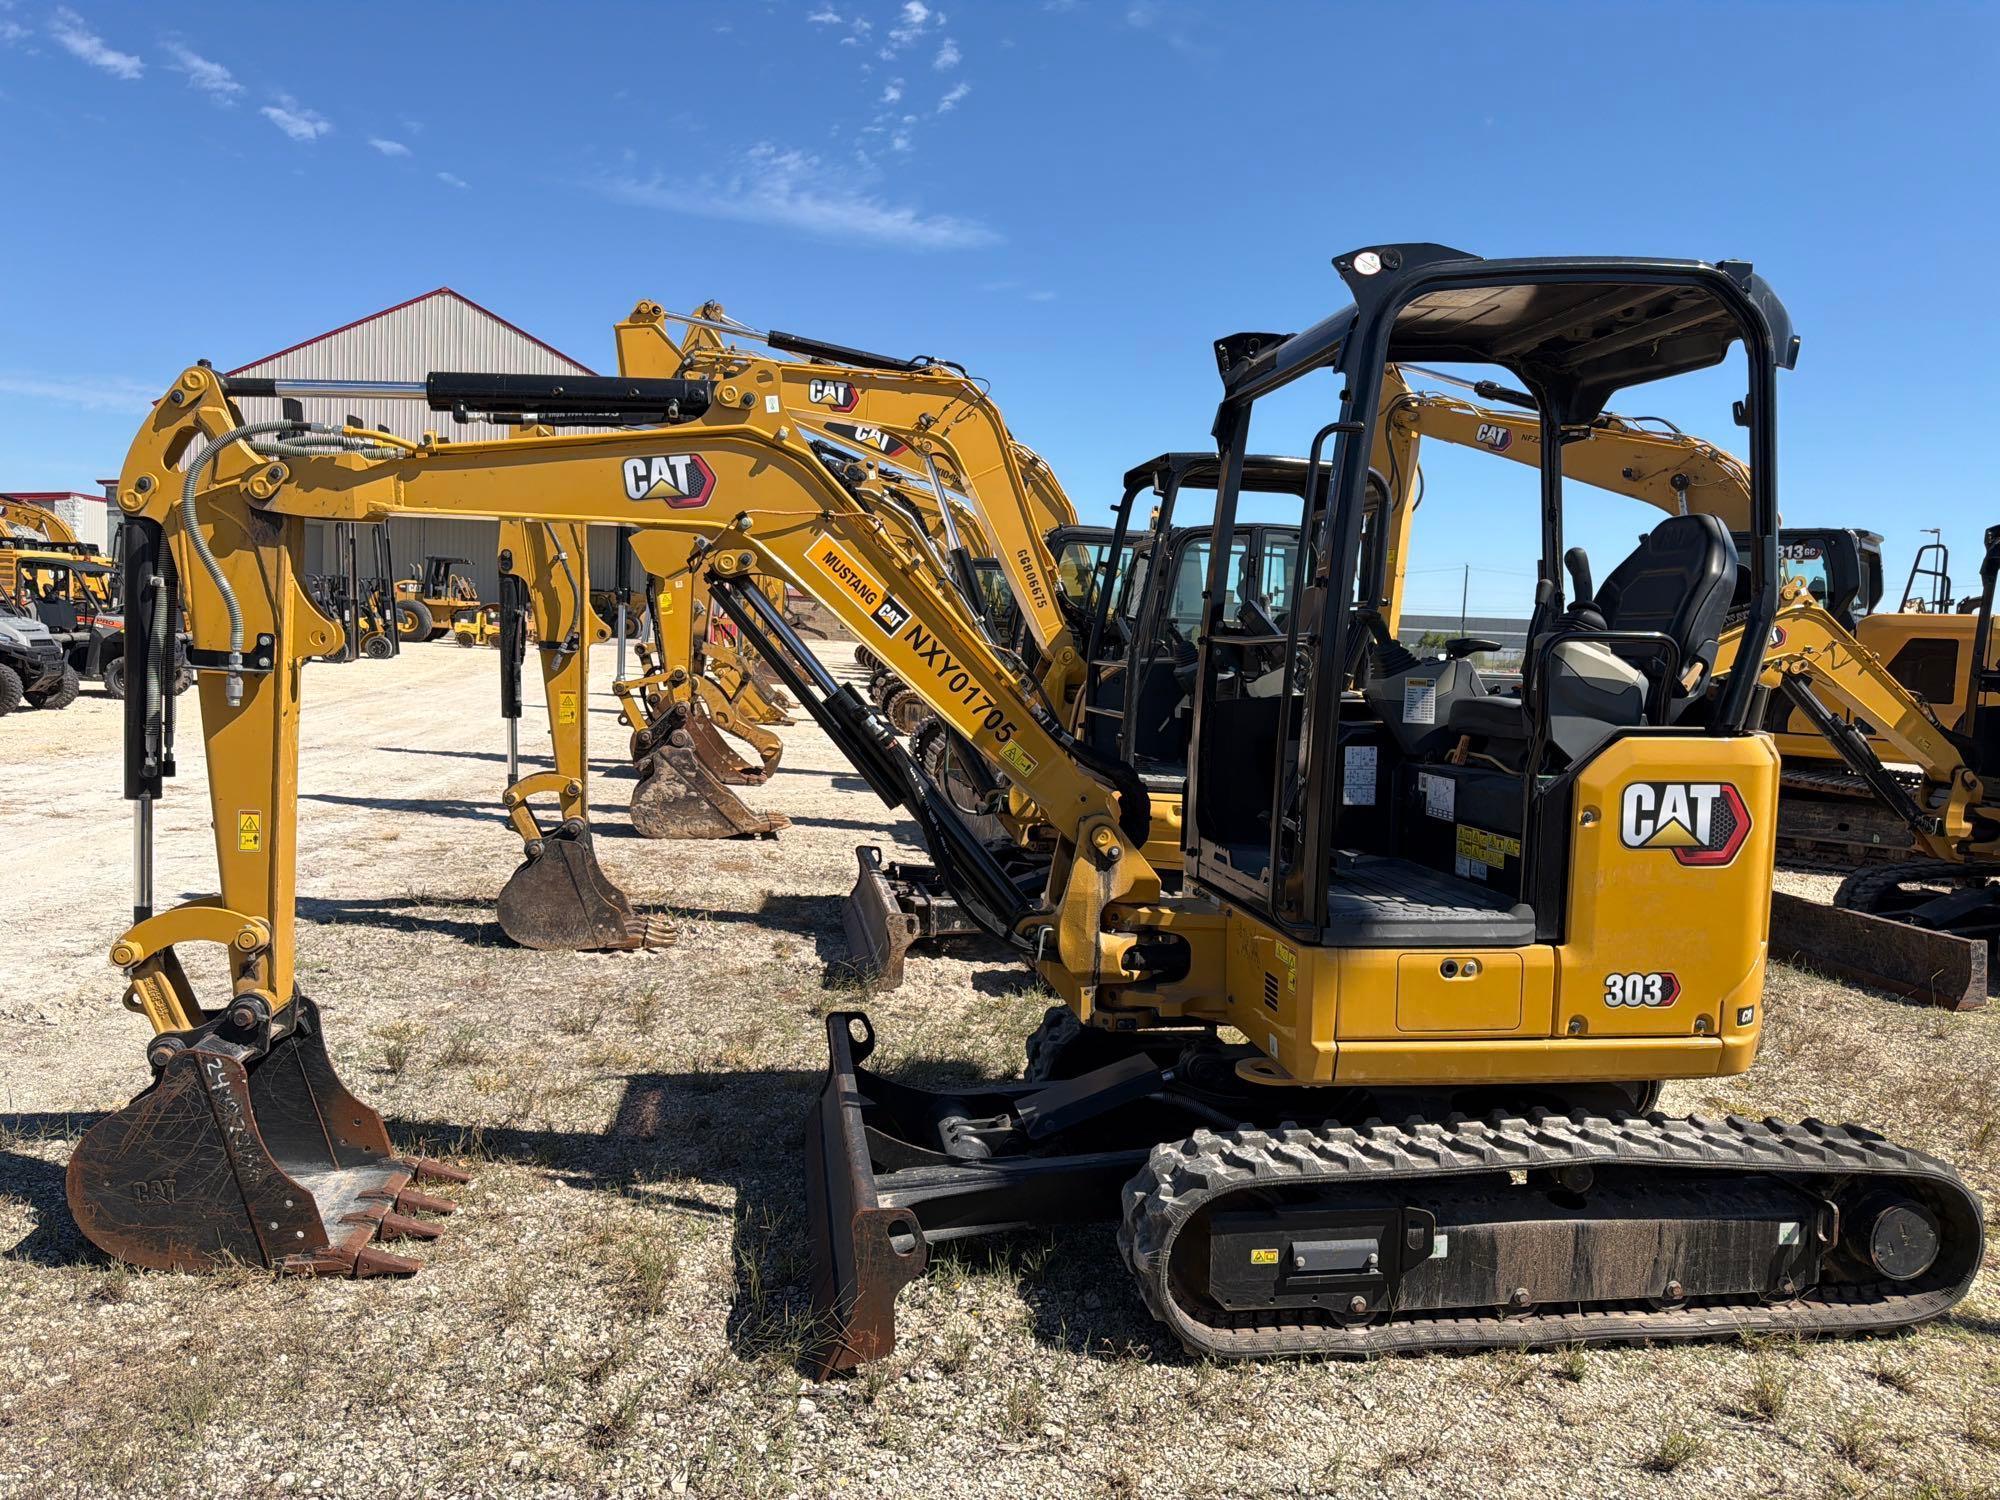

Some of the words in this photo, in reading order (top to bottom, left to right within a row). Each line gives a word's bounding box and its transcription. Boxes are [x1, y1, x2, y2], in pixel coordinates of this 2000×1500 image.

[810, 379, 847, 405] CAT
[1476, 424, 1506, 446] CAT
[1521, 433, 1541, 444] NFZ
[624, 455, 691, 500] CAT
[822, 551, 878, 606] MUSTANG
[878, 603, 904, 628] CAT
[903, 623, 1018, 743] NXY01705
[1622, 783, 1721, 847] CAT
[1605, 974, 1662, 1006] 303
[1741, 1008, 1753, 1023] CR
[132, 1180, 177, 1205] CAT
